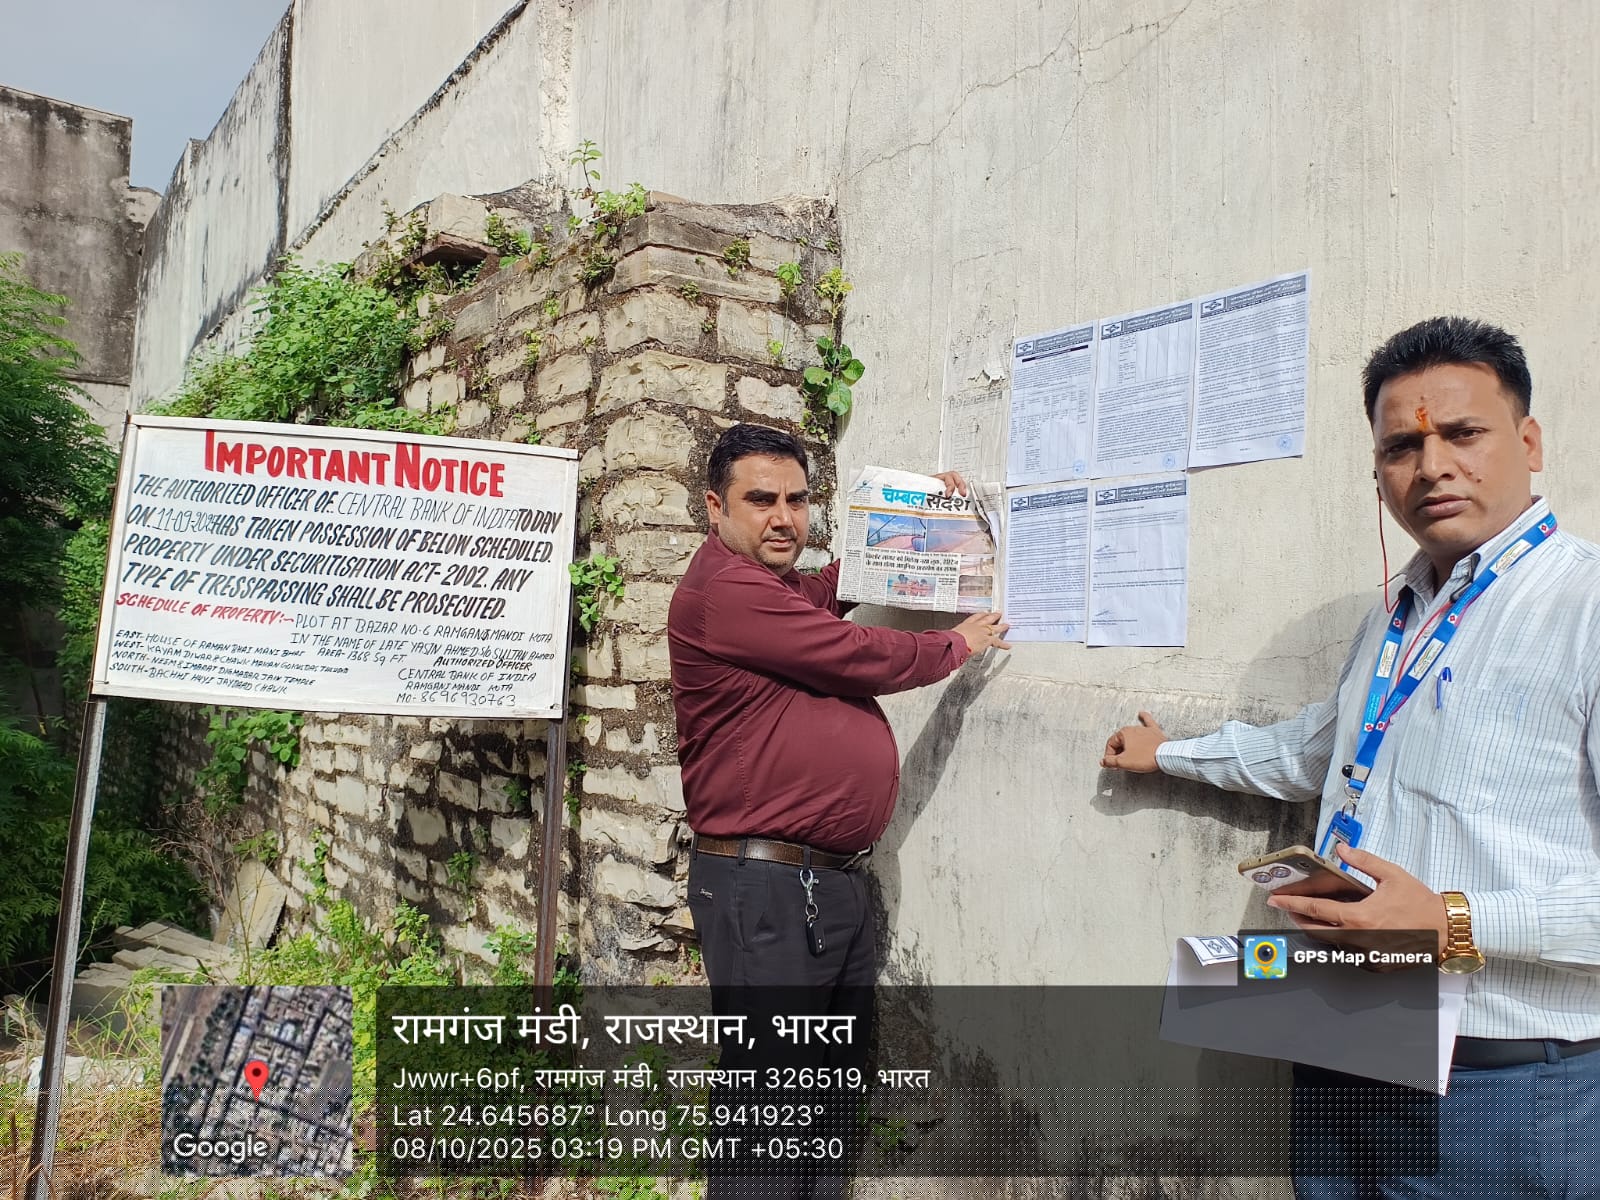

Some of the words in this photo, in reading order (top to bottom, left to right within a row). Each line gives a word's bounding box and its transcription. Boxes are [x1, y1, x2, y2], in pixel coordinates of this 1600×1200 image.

[205, 430, 390, 486] IMPORTANT
[394, 442, 505, 498] NOTICE
[133, 474, 169, 497] THE
[163, 479, 256, 505] AUTHORIZED
[255, 485, 317, 511] OFFICER
[337, 491, 407, 519] CENTRAL
[410, 497, 454, 523] BANK
[452, 502, 475, 525] OF
[473, 505, 519, 530] INDIA
[515, 508, 563, 534] TODAY
[882, 488, 927, 506] चम्बल
[211, 514, 246, 536] HAS
[245, 516, 302, 542] TAKEN
[299, 521, 398, 550] POSSESSION
[395, 528, 422, 552] OF
[416, 530, 473, 557] BELOW
[123, 533, 215, 562] PROPERTY
[210, 544, 274, 572] UNDER
[271, 550, 405, 581] SECURITISATION
[490, 568, 534, 592] ANY
[122, 561, 174, 588] TYPE
[170, 569, 200, 592] OF
[198, 572, 328, 606] TRESSPASSING
[326, 584, 376, 610] SHALL
[375, 588, 403, 612] BE
[115, 592, 190, 613] SCHEDULE
[191, 603, 211, 616] OF
[295, 613, 330, 629] PLOT
[331, 616, 353, 631] AT
[355, 618, 398, 634] BAZAR
[490, 629, 525, 641] MANDI
[529, 632, 553, 643] KOTA
[145, 633, 182, 646] HOUSE
[183, 639, 199, 648] OF
[290, 632, 311, 645] IN
[312, 634, 335, 646] THE
[334, 636, 364, 650] NAME
[363, 639, 377, 650] OF
[379, 640, 409, 650] LATE
[444, 644, 479, 657] AHMED
[398, 668, 446, 680] CENTRAL
[449, 670, 479, 680] BANK
[480, 672, 494, 680] OF
[497, 673, 536, 681] INDIA
[433, 656, 495, 668] AUTHORIZED
[496, 660, 533, 671] OFFICER
